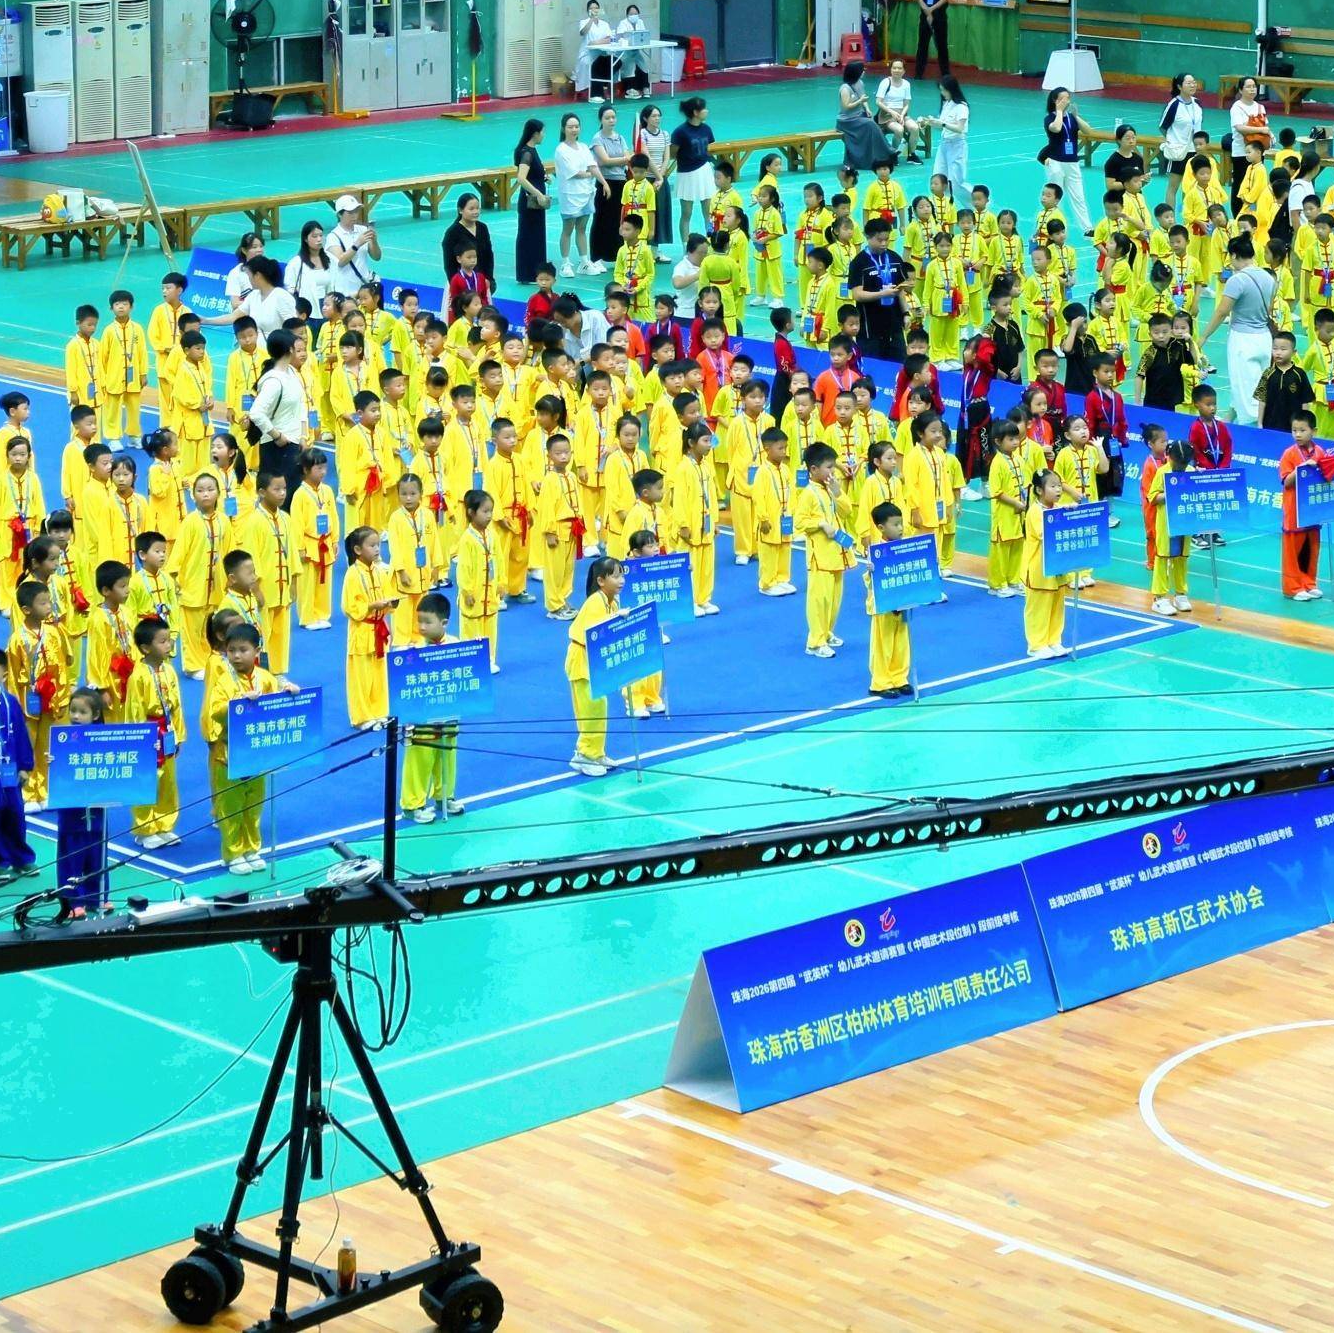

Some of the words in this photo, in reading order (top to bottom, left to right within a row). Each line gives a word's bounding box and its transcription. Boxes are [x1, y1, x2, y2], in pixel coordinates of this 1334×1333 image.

[1180, 489, 1235, 503] 中山市坦洲镇
[1054, 523, 1099, 541] 珠海市香洲区
[405, 665, 474, 685] 珠海市金湾区
[399, 678, 481, 700] 时代文正幼儿园
[244, 714, 308, 734] 珠海市香洲区
[250, 730, 303, 749] 珠洲幼儿园
[67, 750, 139, 765] 珠海市香洲区
[1109, 885, 1267, 953] 珠海高新区武术协会
[747, 958, 1032, 1066] 珠海市香洲区柏林体育培训有限责任公司
